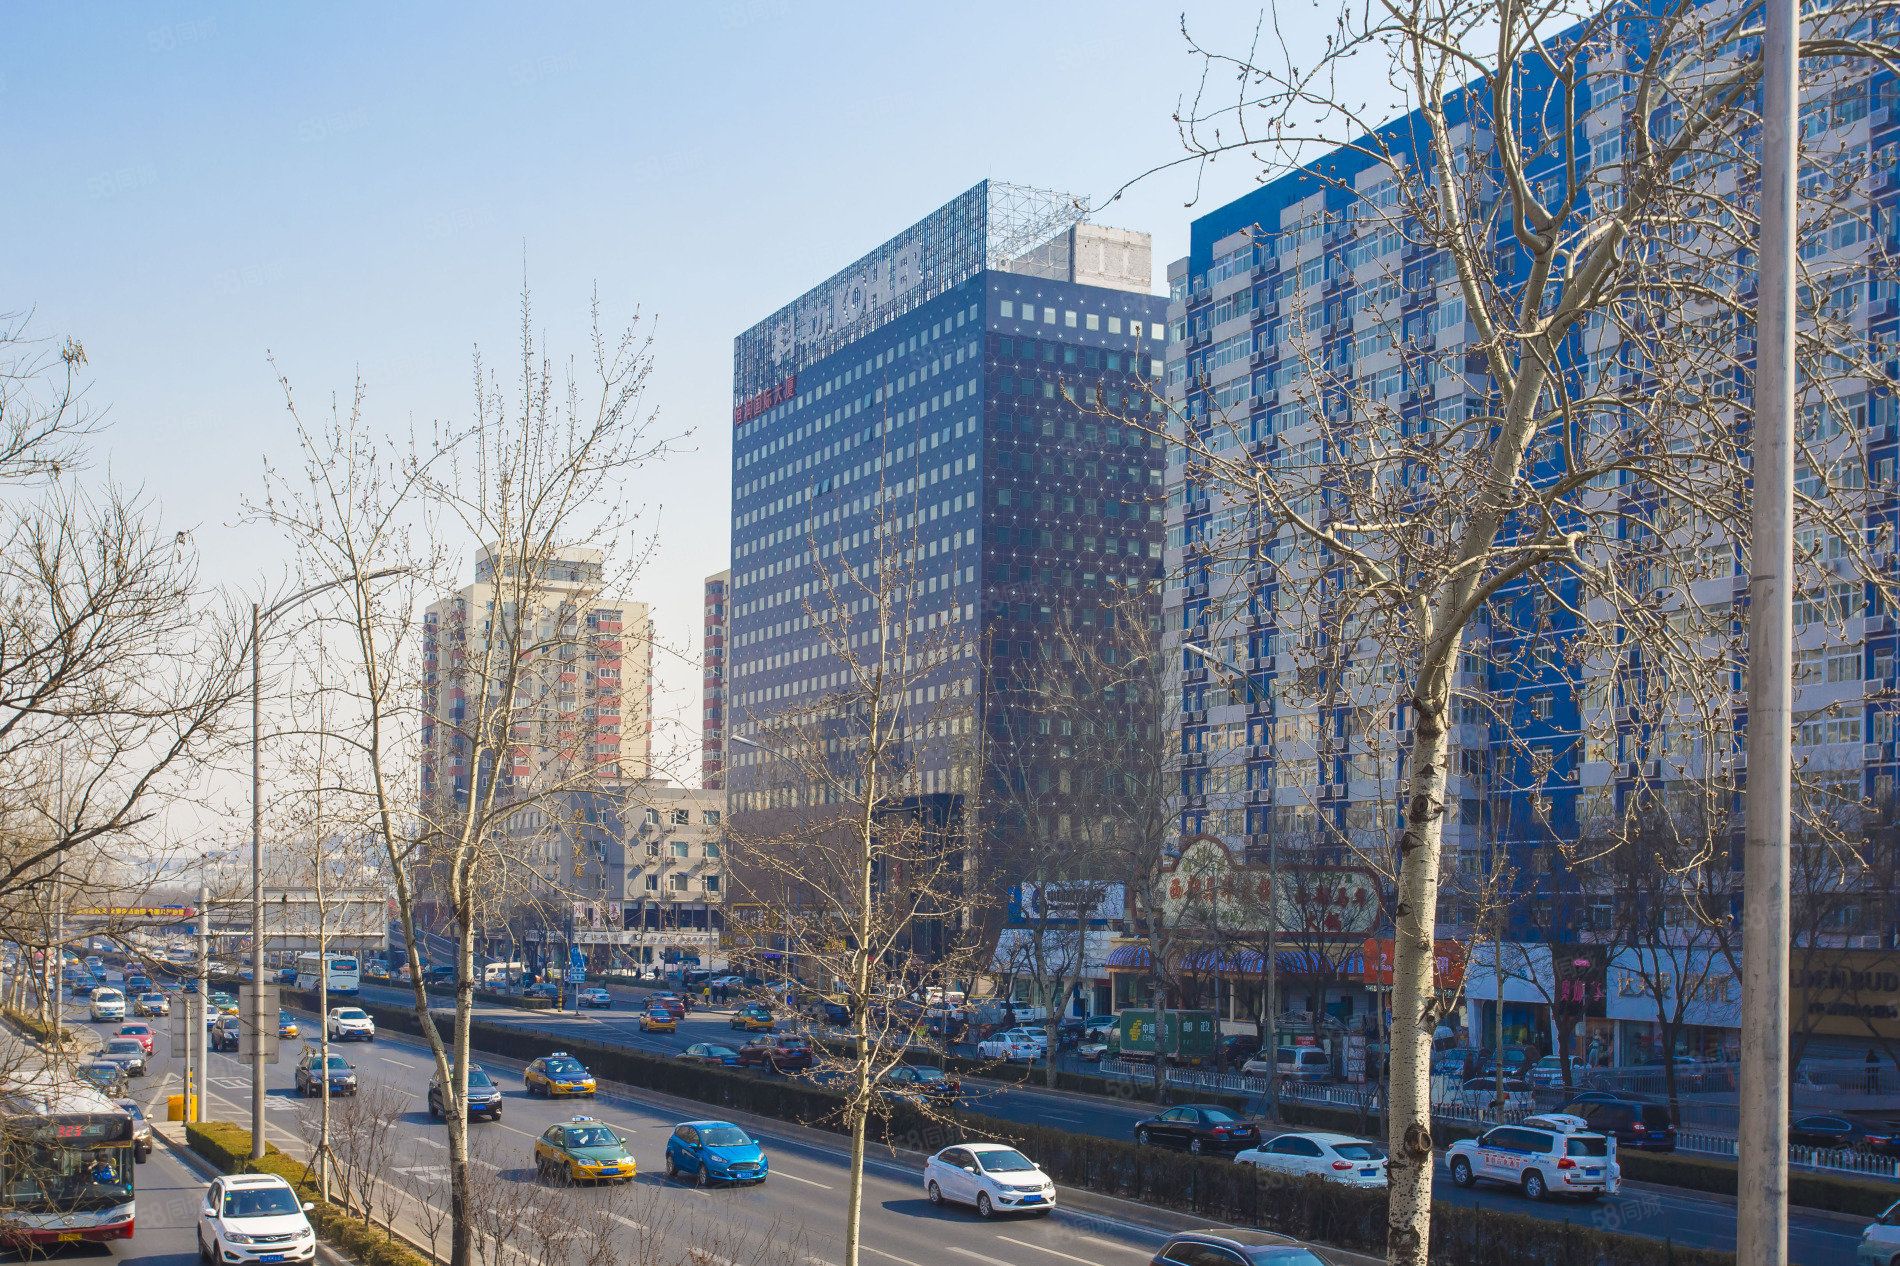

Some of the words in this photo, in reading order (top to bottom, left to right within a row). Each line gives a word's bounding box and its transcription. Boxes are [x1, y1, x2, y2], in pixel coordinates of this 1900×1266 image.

[771, 302, 829, 365] 科勒
[832, 241, 924, 331] KOHLER
[1183, 1021, 1210, 1032] 邮政
